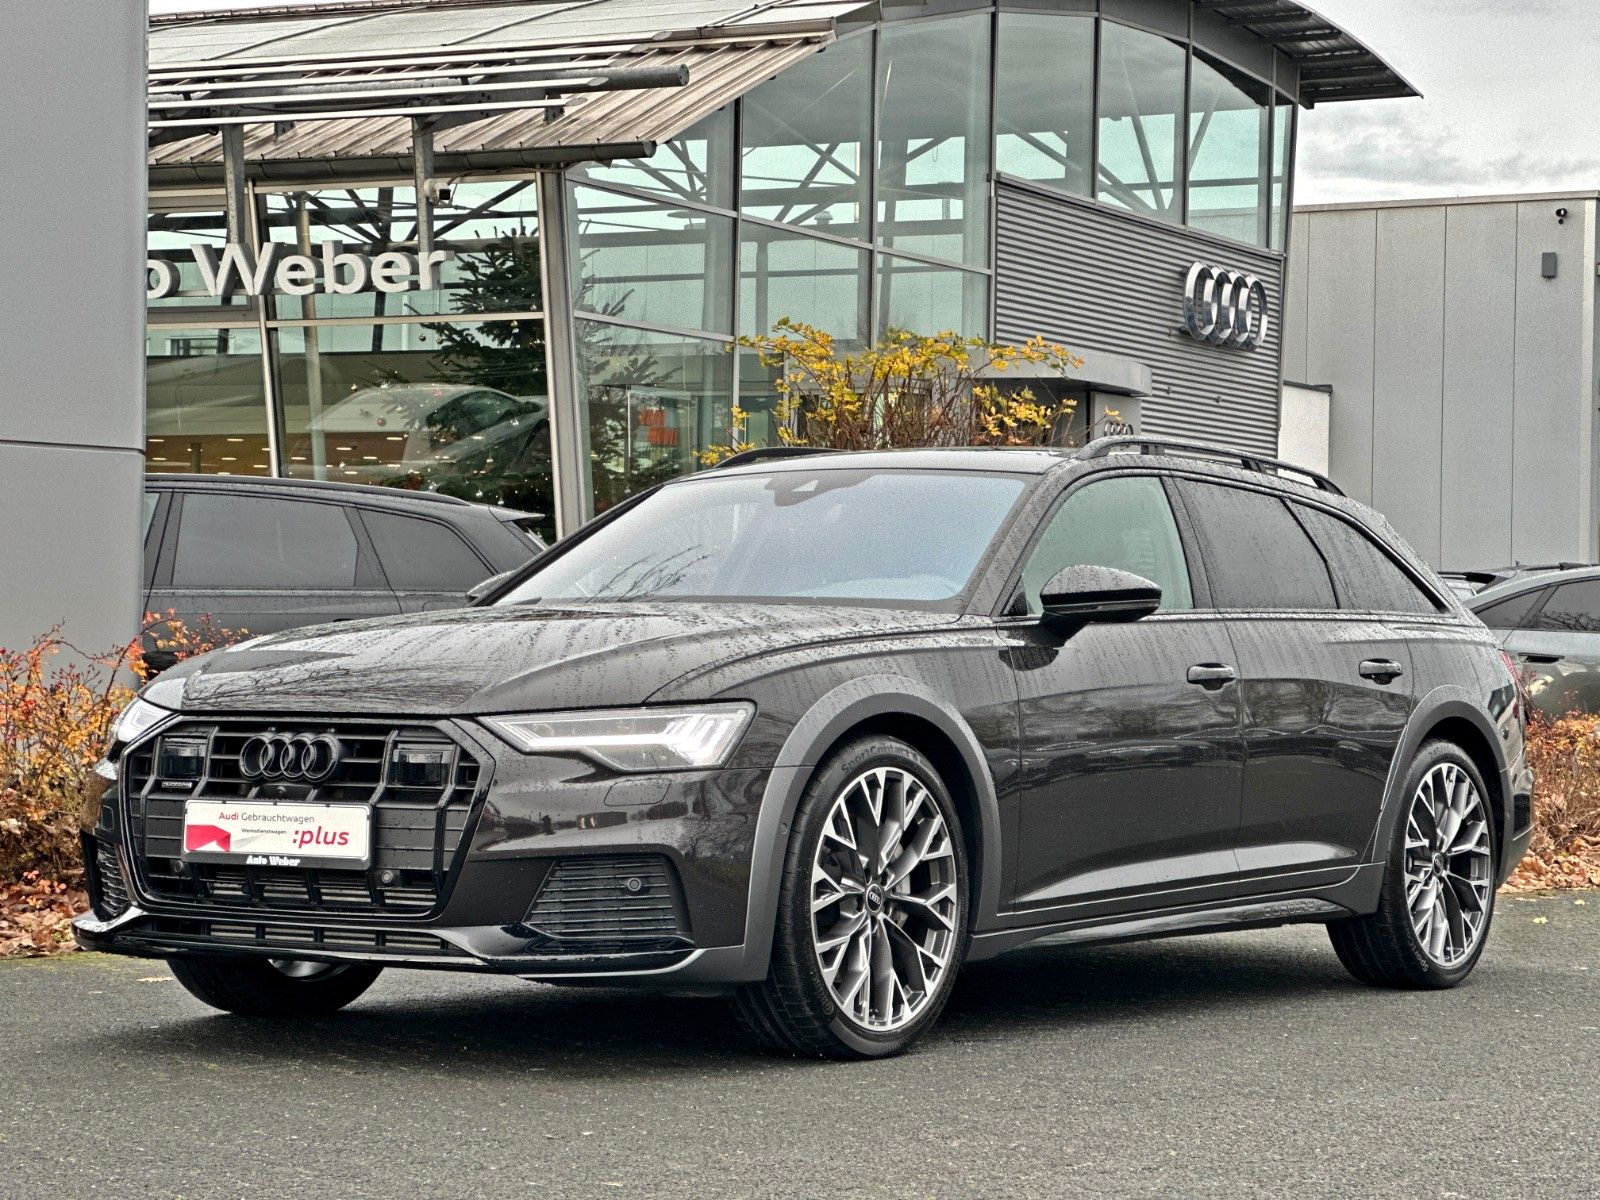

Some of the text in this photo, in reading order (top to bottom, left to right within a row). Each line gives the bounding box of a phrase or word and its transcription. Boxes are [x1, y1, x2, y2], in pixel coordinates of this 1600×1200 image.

[190, 239, 454, 296] Weber
[218, 811, 315, 825] Audi Gebrauchtwagen
[292, 825, 350, 849] :plus
[245, 854, 301, 867] Auto Weber
